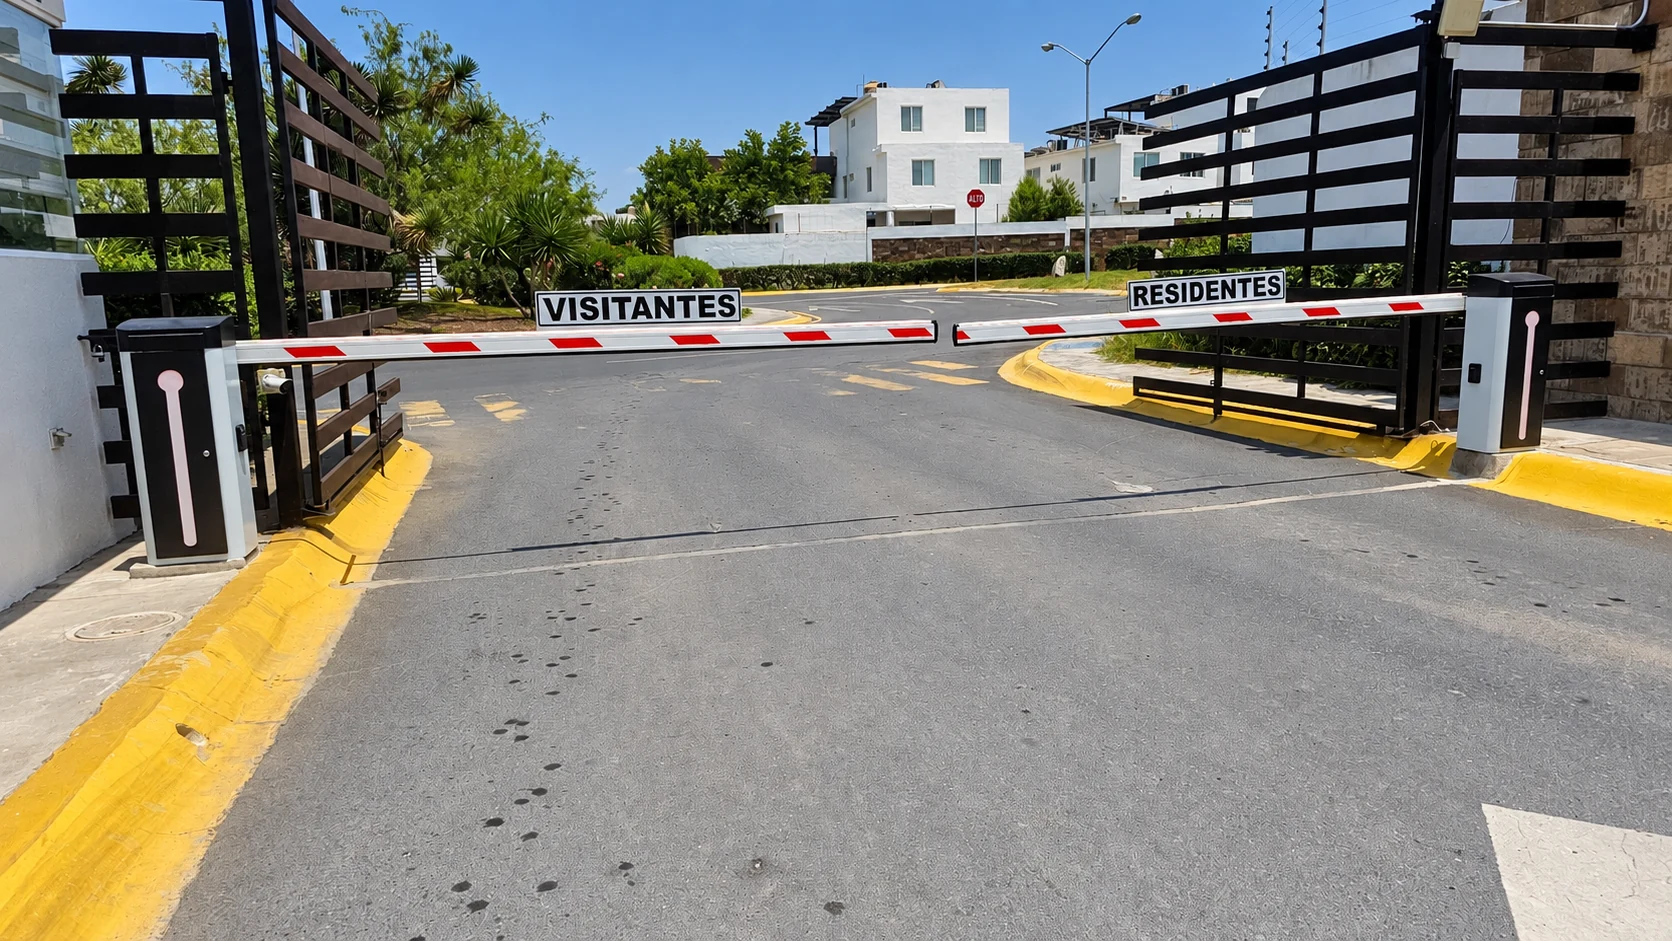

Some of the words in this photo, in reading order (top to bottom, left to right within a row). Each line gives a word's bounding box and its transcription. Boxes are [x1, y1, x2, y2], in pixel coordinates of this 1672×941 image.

[969, 194, 984, 203] ALTO
[1133, 275, 1281, 306] RESIDENTES
[543, 294, 736, 321] VISITANTES
